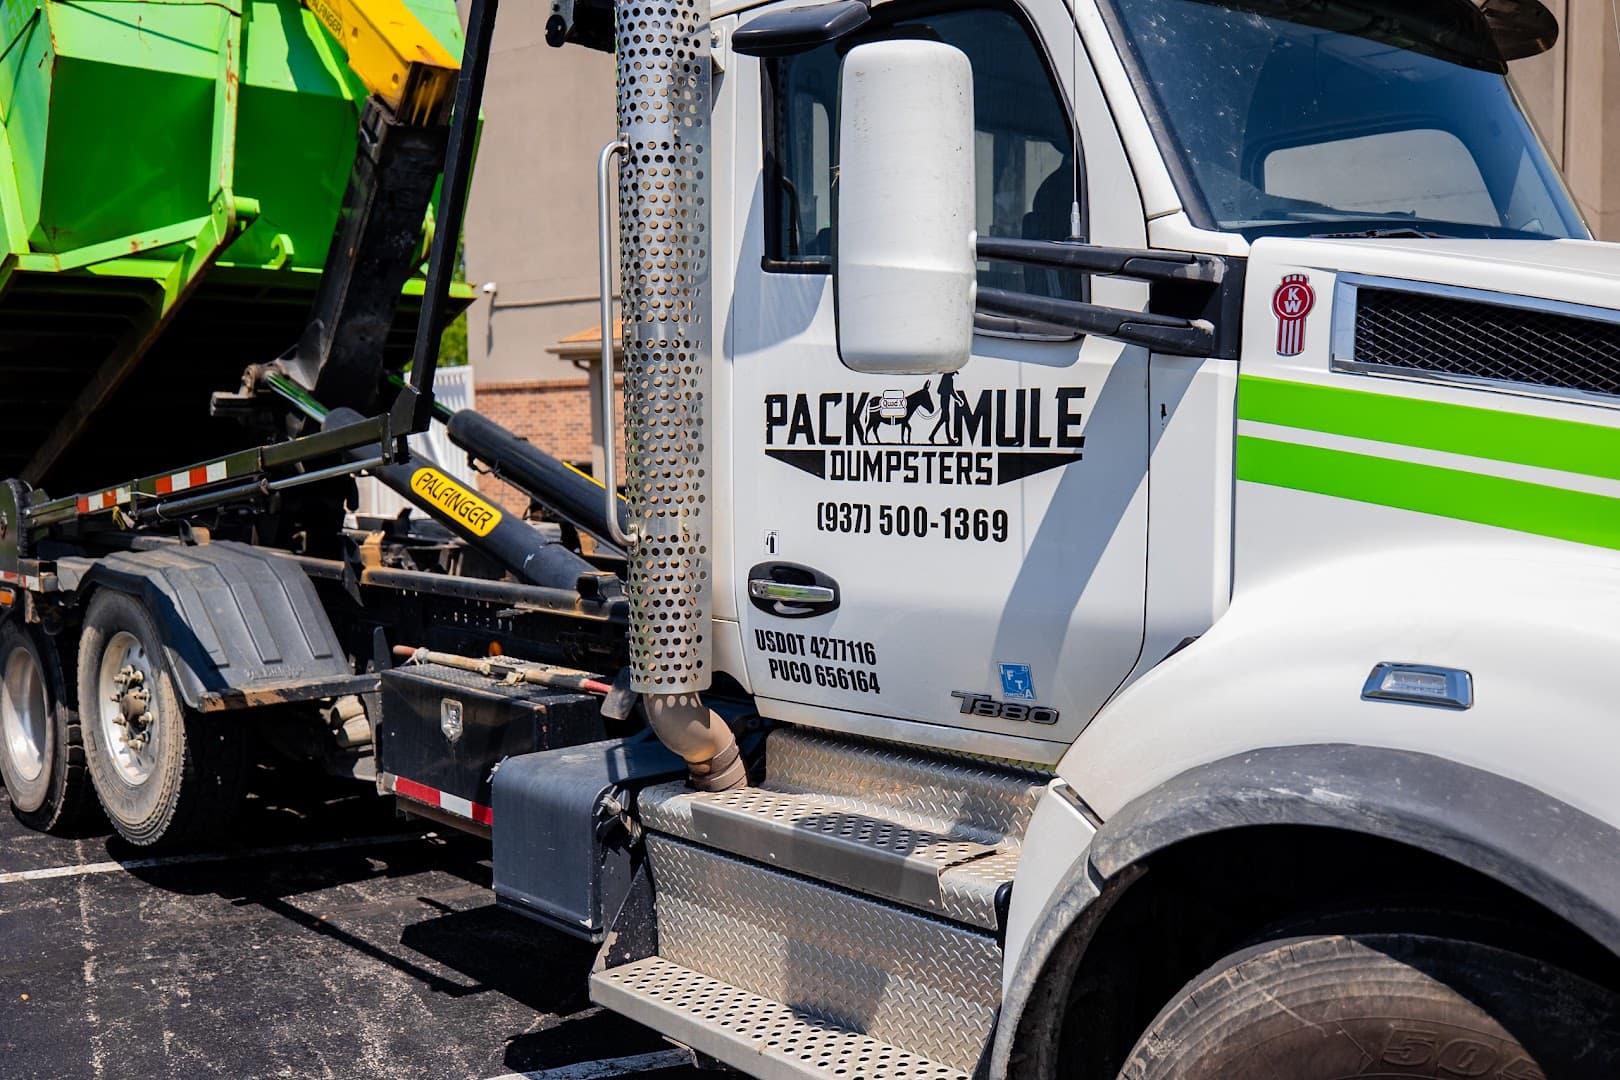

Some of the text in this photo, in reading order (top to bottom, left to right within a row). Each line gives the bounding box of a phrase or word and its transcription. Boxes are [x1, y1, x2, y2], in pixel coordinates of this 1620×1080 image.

[765, 386, 1087, 449] PACK MULE
[830, 450, 992, 486] DUMPSTERS
[416, 472, 493, 531] PALFINGER
[817, 502, 1009, 542] (937) 500-1369
[755, 628, 877, 665] USDOT 4277116
[768, 658, 880, 694] PUCO 656164
[951, 690, 1059, 725] T880
